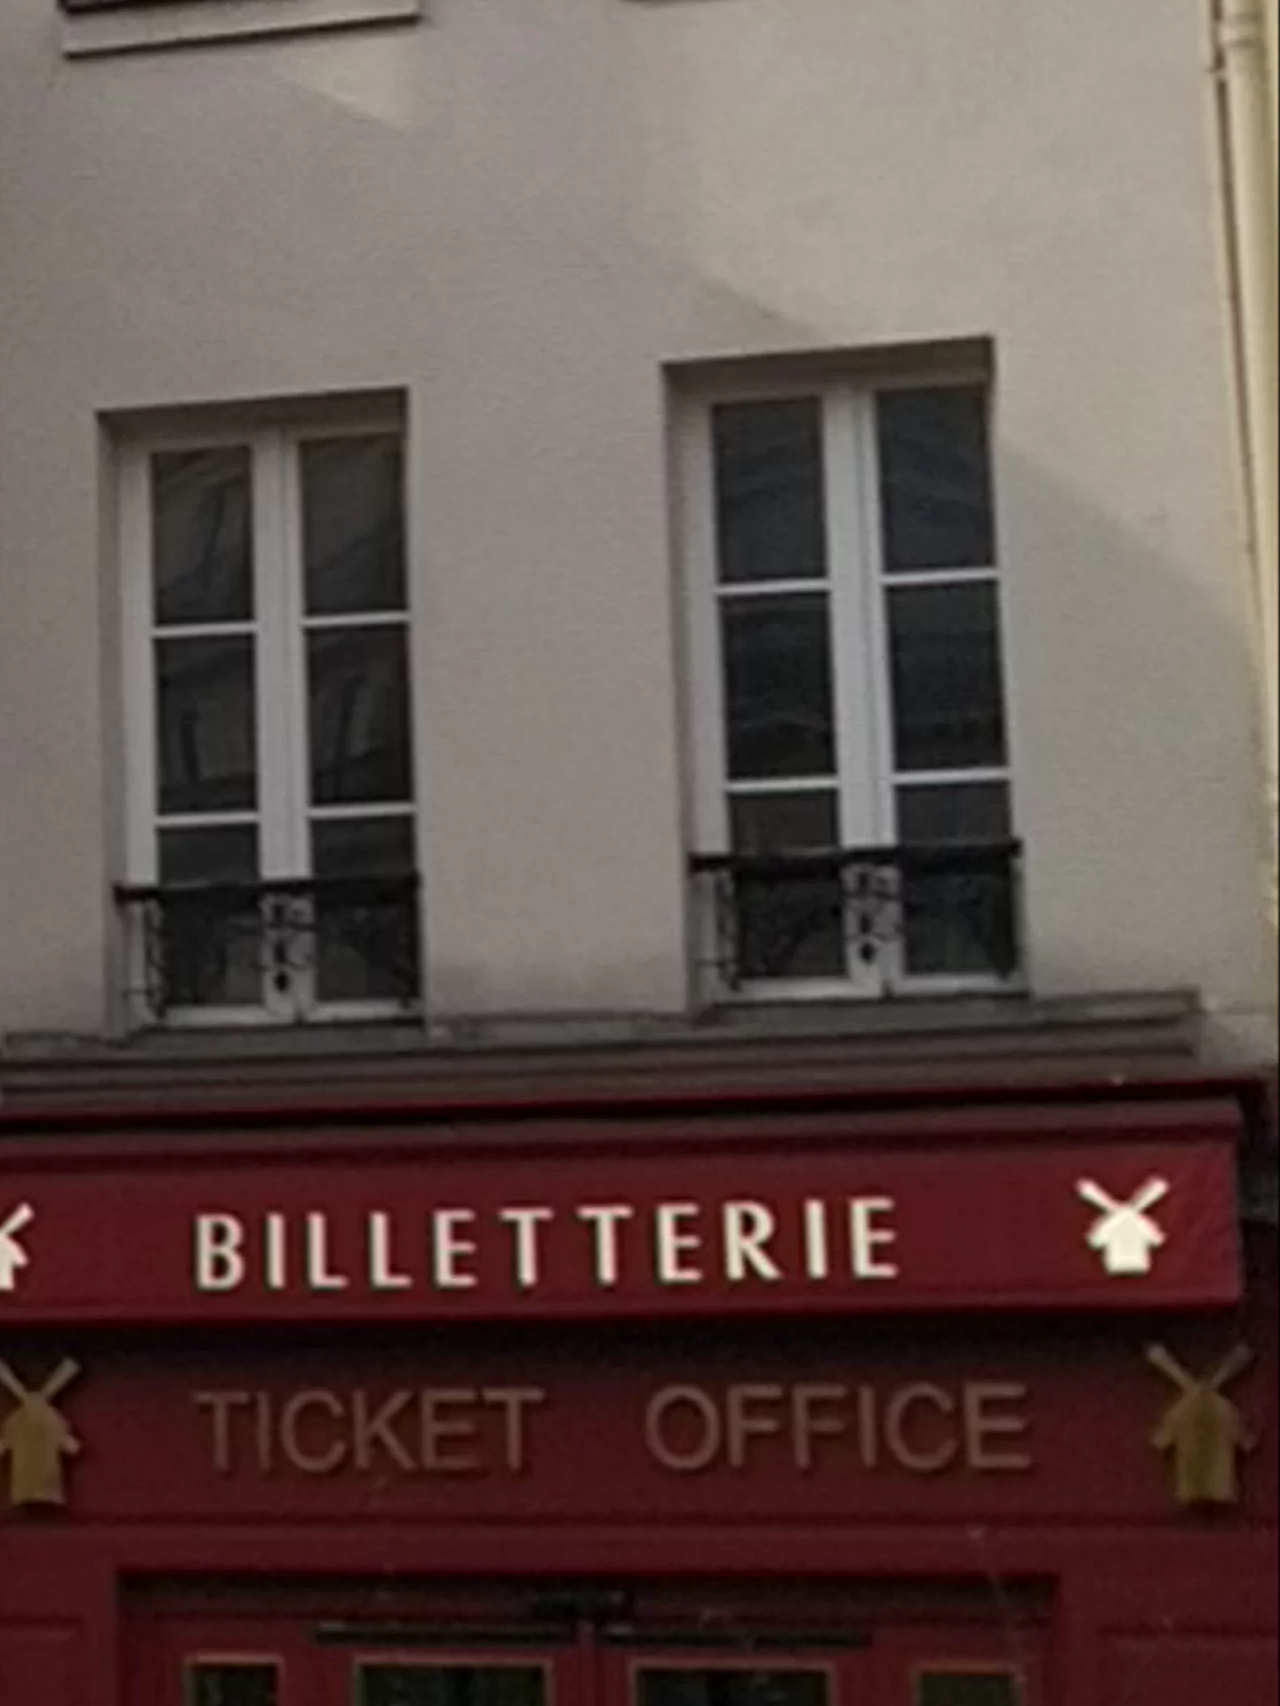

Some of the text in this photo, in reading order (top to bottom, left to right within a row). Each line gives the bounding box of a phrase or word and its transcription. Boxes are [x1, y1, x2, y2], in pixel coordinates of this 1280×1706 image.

[194, 1196, 900, 1291] BILLETTERIE
[192, 1382, 1035, 1471] TICKET OFFICE
